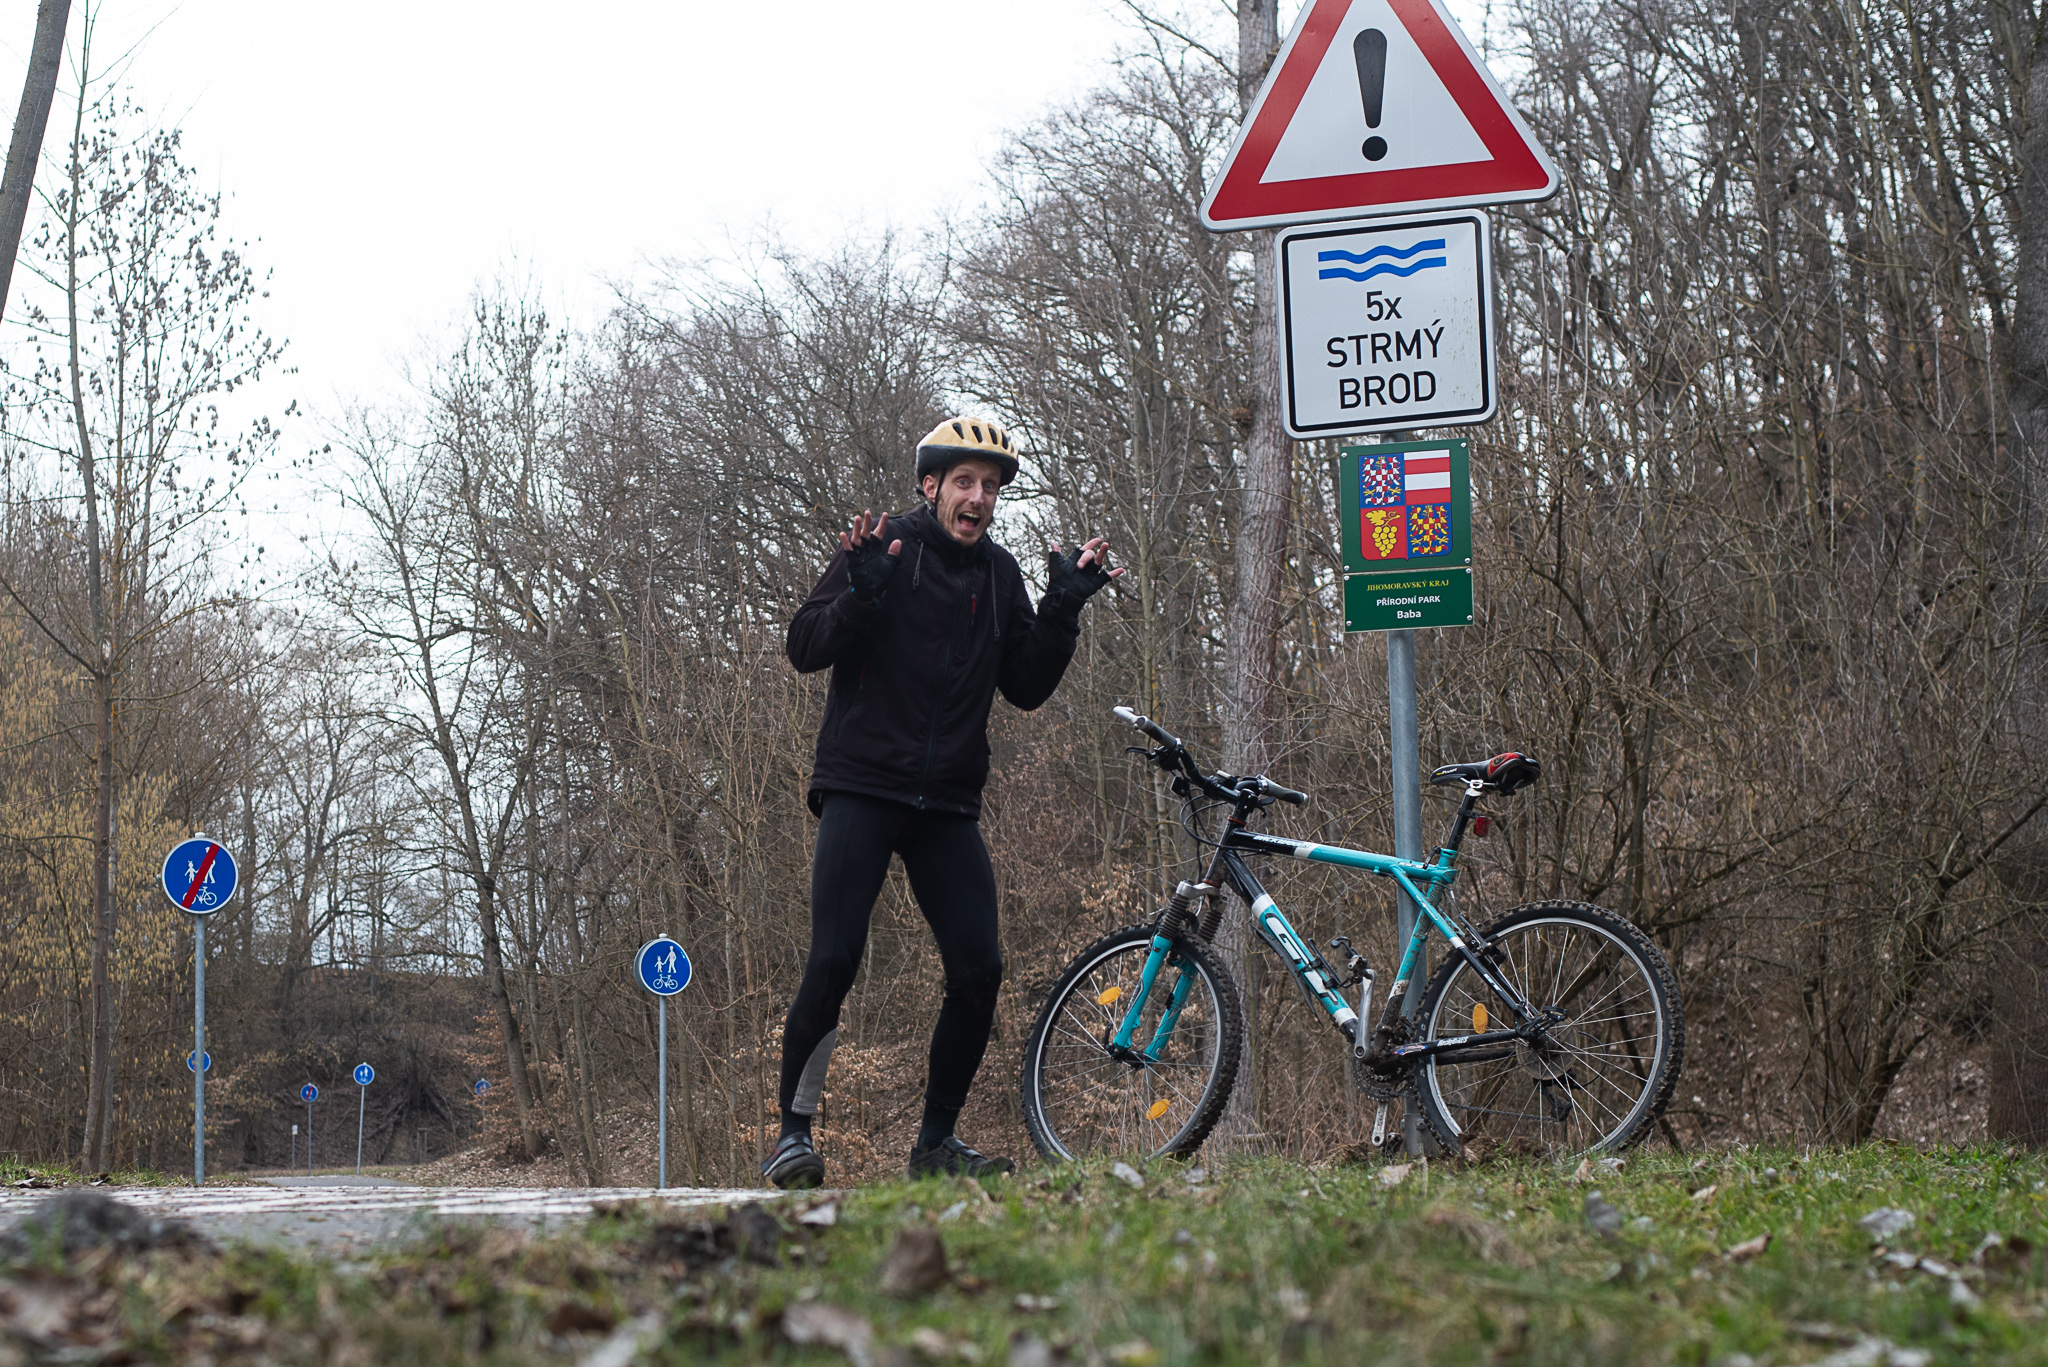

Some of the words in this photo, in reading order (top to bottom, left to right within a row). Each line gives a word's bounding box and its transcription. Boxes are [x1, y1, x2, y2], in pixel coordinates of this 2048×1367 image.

[1366, 290, 1403, 322] 5x
[1326, 318, 1445, 368] STRMÝ
[1339, 370, 1437, 410] BROD
[1366, 580, 1428, 592] JIHOMORAVSKÝ
[1429, 579, 1450, 588] KRAJ
[1376, 595, 1417, 607] PŘÍRODNÍ
[1418, 595, 1441, 604] PARK
[1396, 609, 1422, 619] Baba
